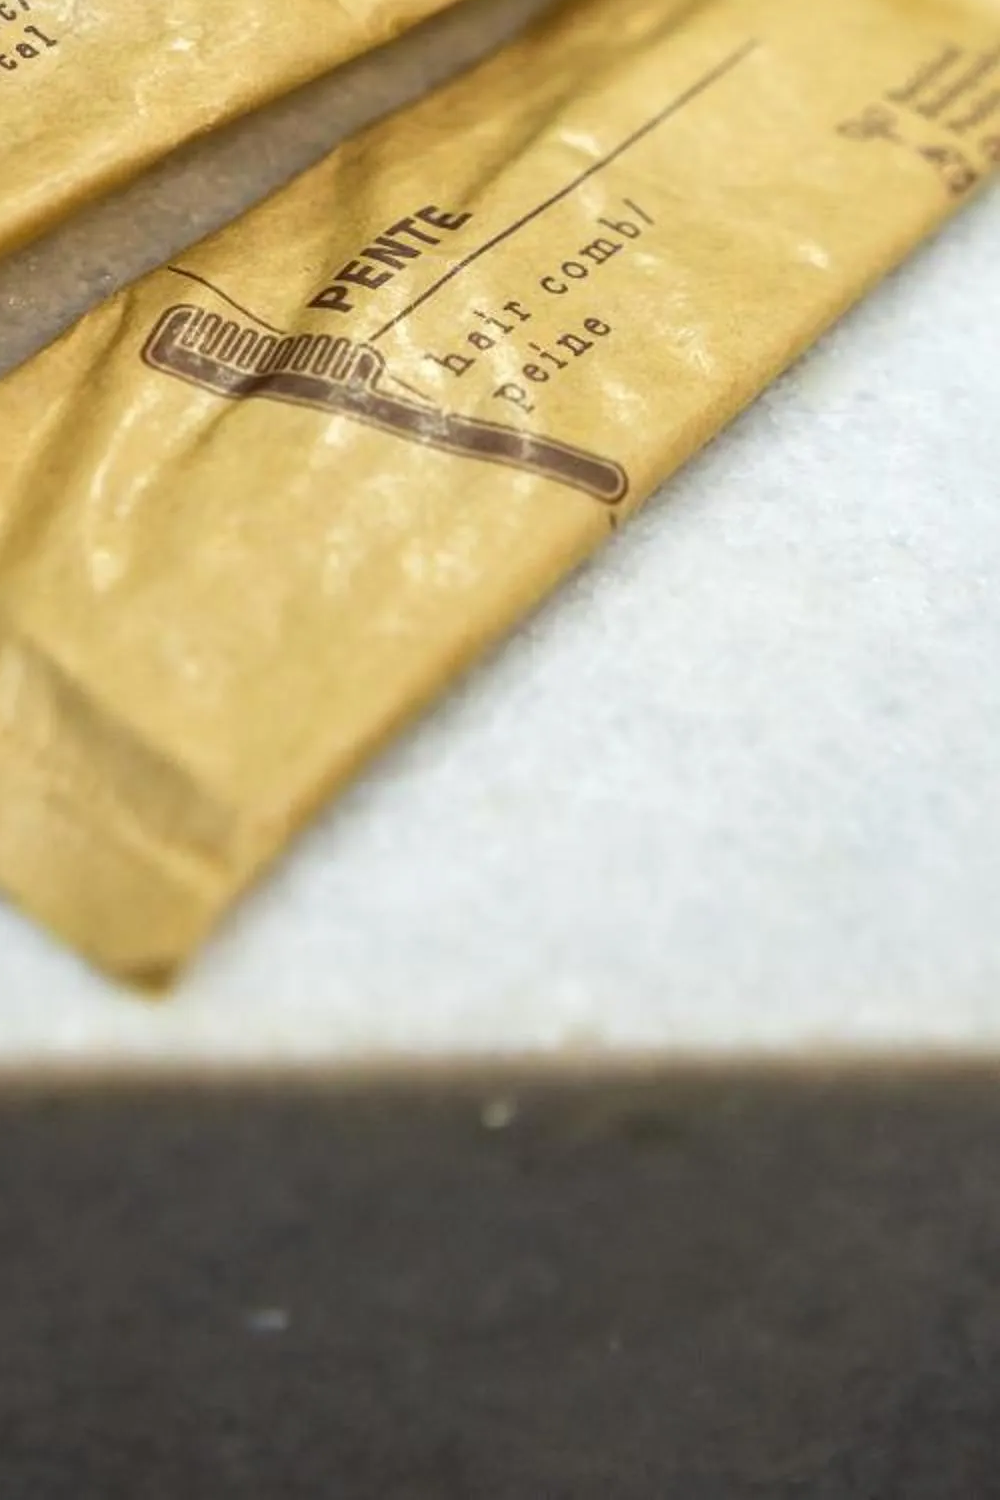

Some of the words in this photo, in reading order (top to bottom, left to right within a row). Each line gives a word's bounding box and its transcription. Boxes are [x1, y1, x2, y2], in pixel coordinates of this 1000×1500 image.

[307, 204, 473, 313] PENTE
[425, 300, 532, 378] hair
[540, 198, 655, 296] comb/
[493, 313, 613, 414] peine
